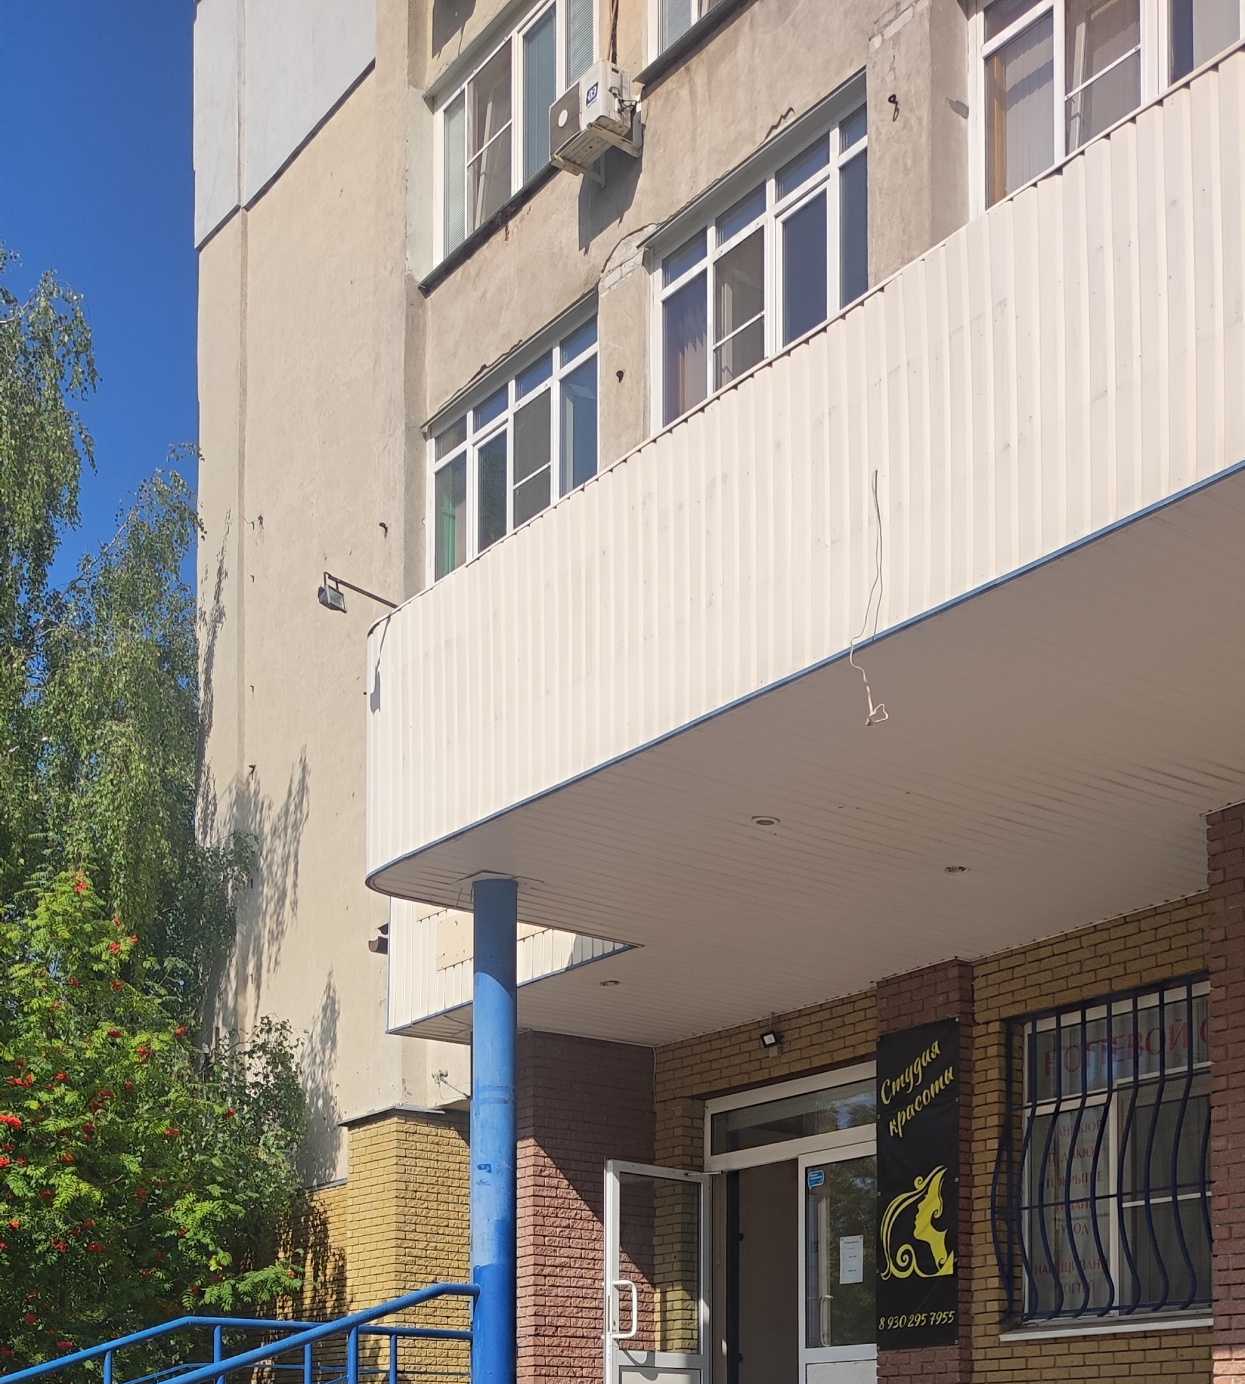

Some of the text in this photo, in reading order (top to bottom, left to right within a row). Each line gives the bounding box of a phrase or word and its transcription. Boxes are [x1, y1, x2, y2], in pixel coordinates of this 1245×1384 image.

[881, 1040, 941, 1105] Студия
[879, 1310, 956, 1330] 8 930 295 7955
